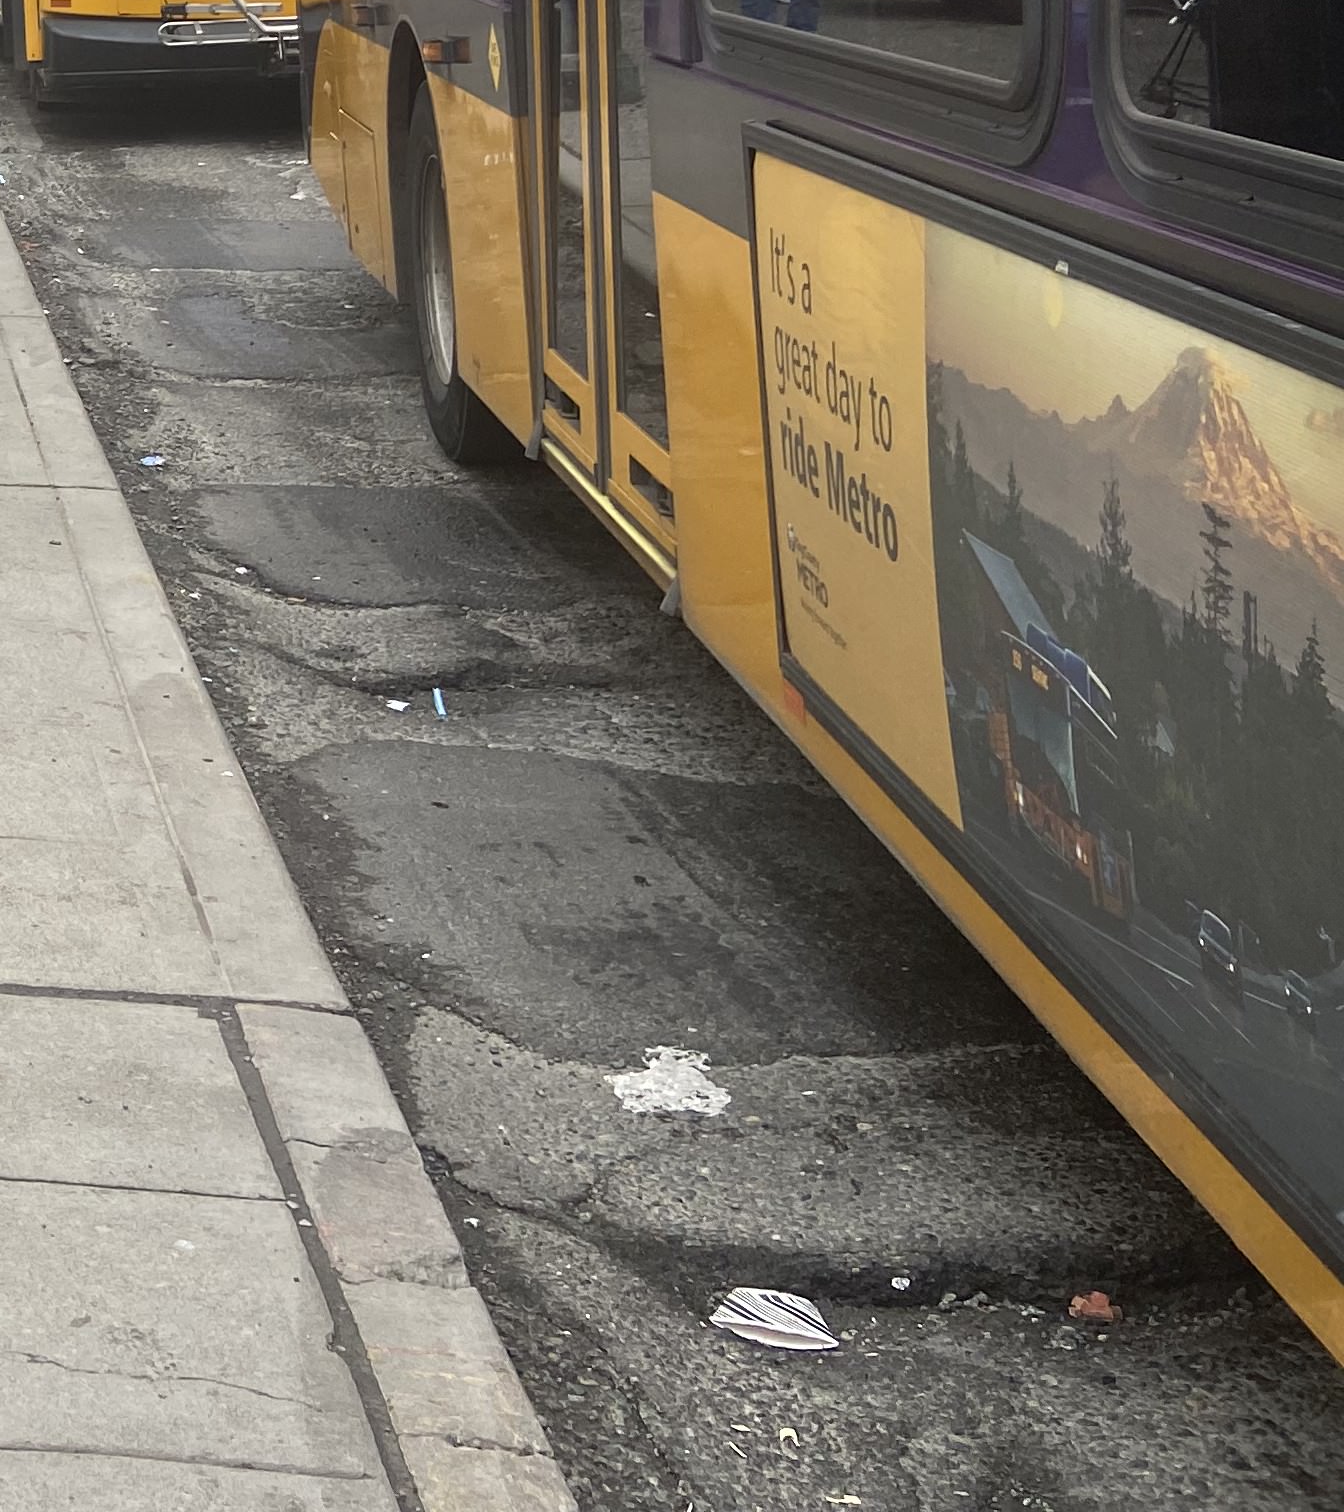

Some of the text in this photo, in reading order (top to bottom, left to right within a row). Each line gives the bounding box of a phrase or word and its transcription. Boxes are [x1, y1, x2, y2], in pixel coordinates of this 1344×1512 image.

[769, 227, 813, 316] It's a
[774, 324, 892, 453] great day to
[780, 406, 899, 563] ride Metro
